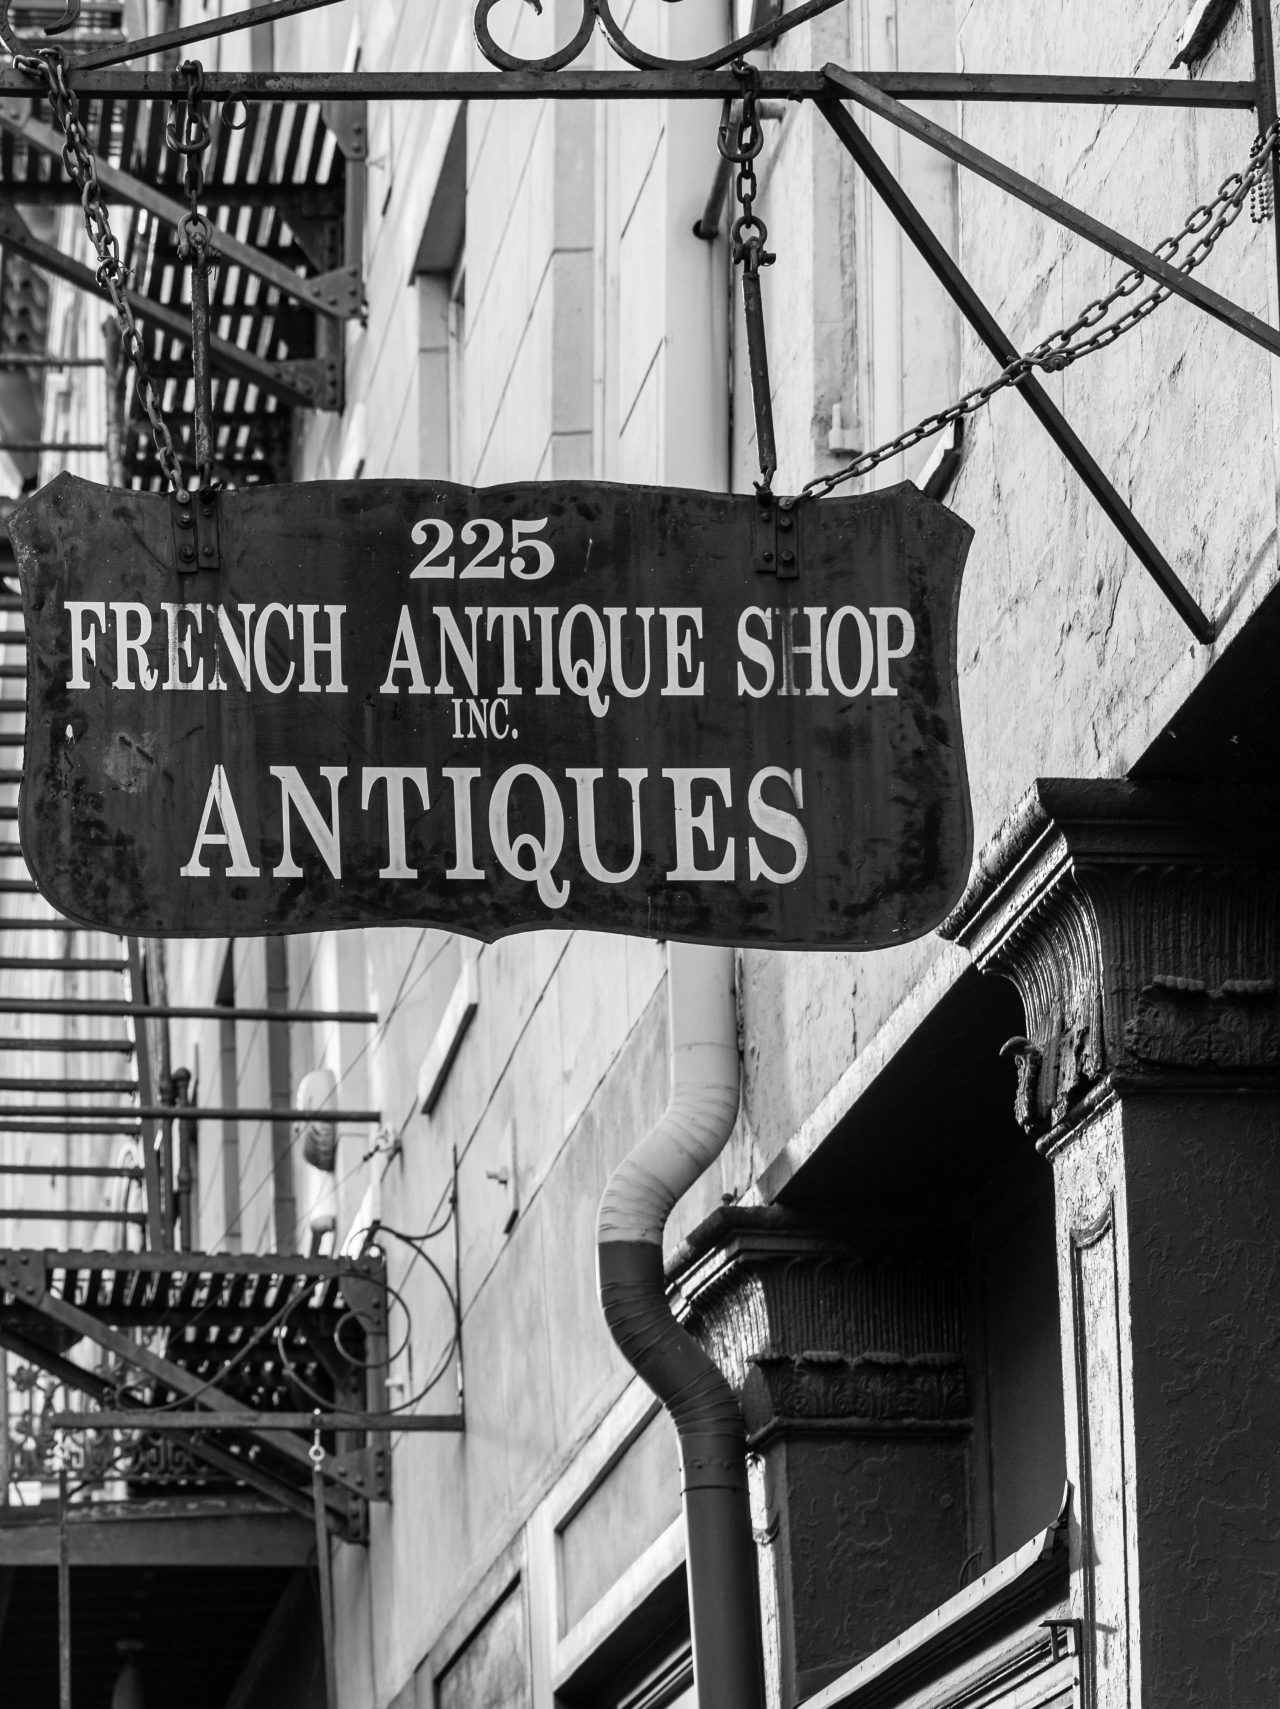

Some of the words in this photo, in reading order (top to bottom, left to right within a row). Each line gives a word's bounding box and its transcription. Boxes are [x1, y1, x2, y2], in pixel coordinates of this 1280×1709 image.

[410, 517, 554, 579] 225
[64, 601, 349, 694] FRENCH
[380, 603, 705, 717] ANTIQUE
[737, 605, 916, 698] SHOP
[452, 698, 519, 740] INC.
[180, 764, 808, 909] ANTIQUES
